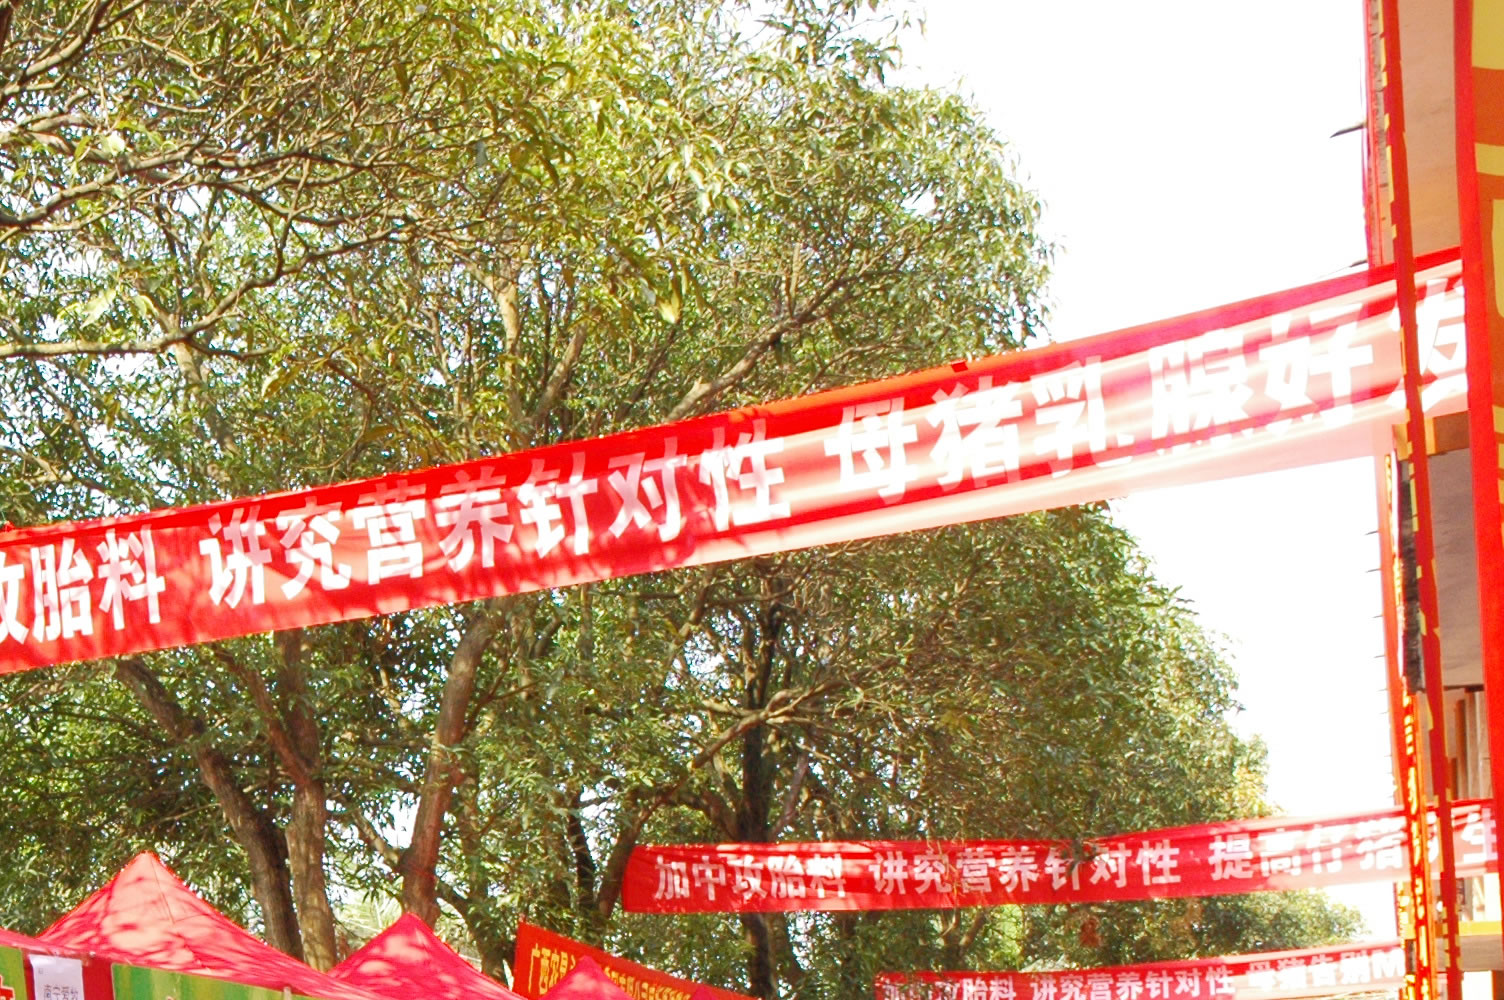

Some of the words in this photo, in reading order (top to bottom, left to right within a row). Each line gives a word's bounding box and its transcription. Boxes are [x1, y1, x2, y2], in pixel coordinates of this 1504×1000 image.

[200, 418, 791, 609] 讲究营养针对性
[655, 854, 846, 898] 加中攻胎料
[869, 837, 1181, 896] 讲究营养针对性
